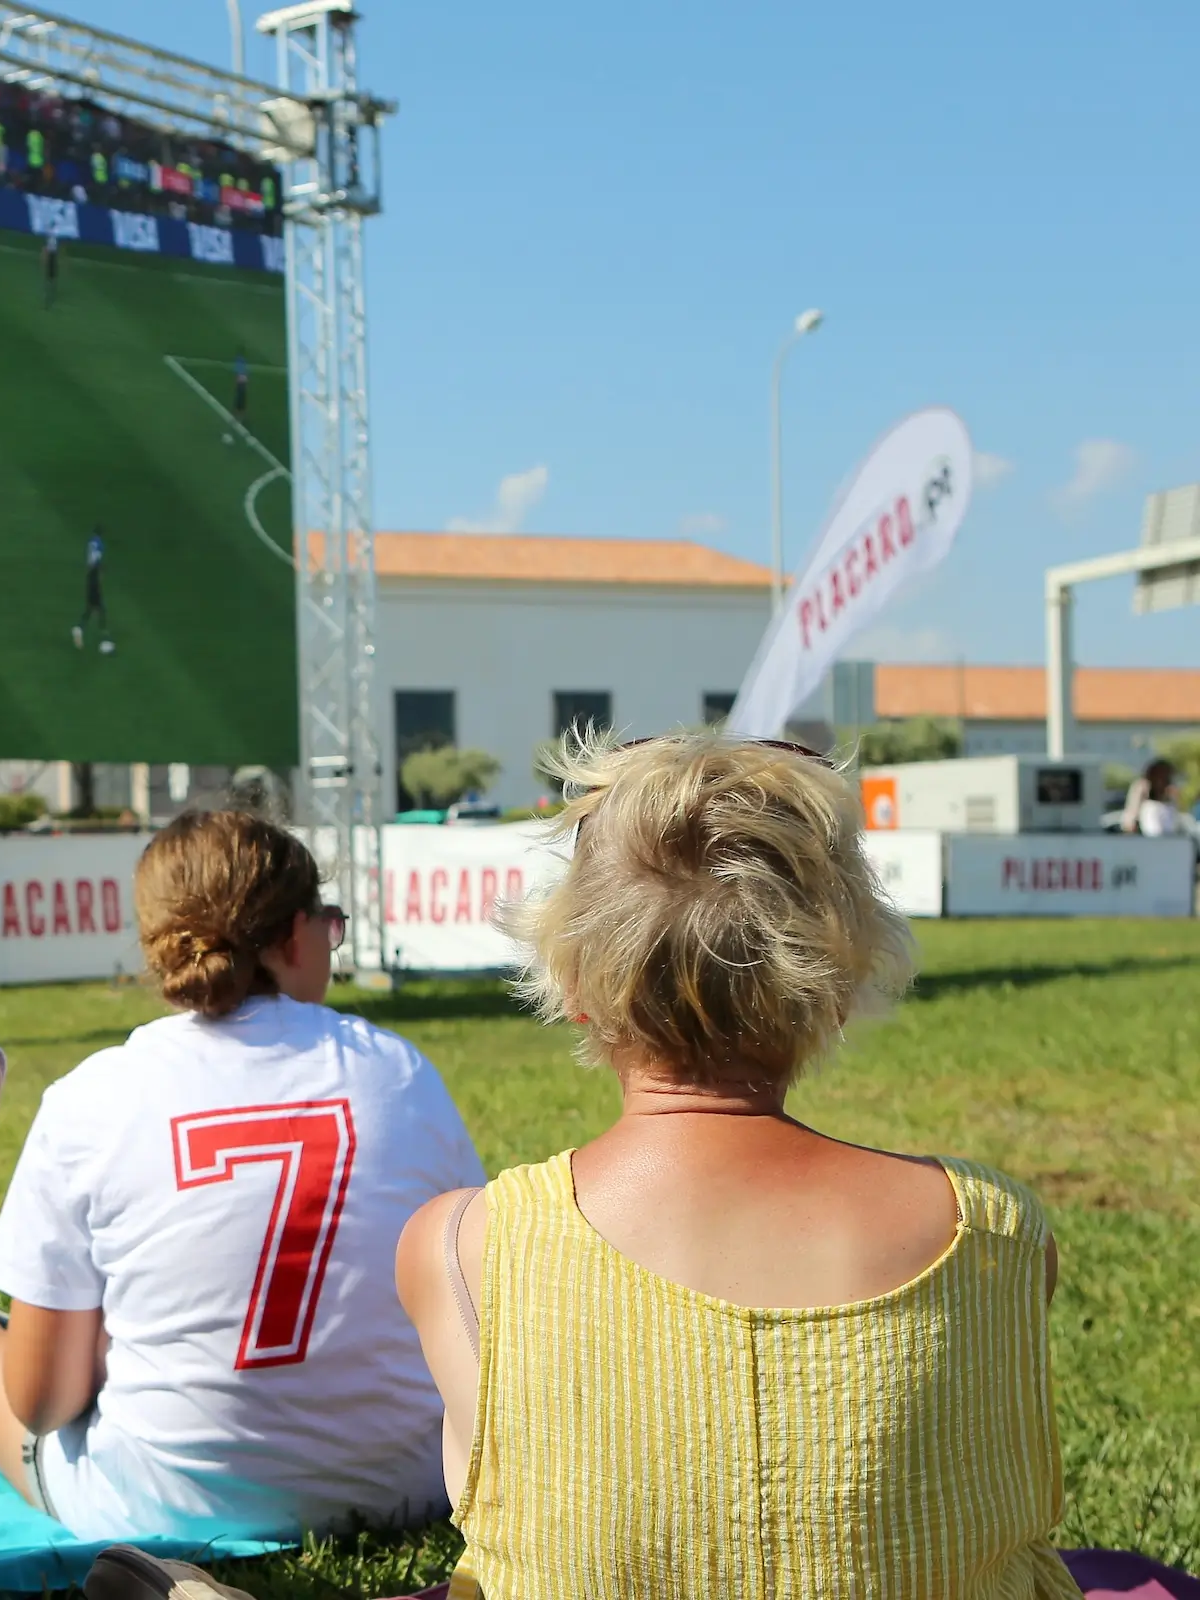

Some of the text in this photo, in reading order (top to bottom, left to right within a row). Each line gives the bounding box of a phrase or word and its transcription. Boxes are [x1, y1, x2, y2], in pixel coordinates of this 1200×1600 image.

[25, 193, 80, 239] VISA
[110, 207, 160, 252] VISA
[187, 220, 235, 264] VISA
[171, 1098, 356, 1370] 7
